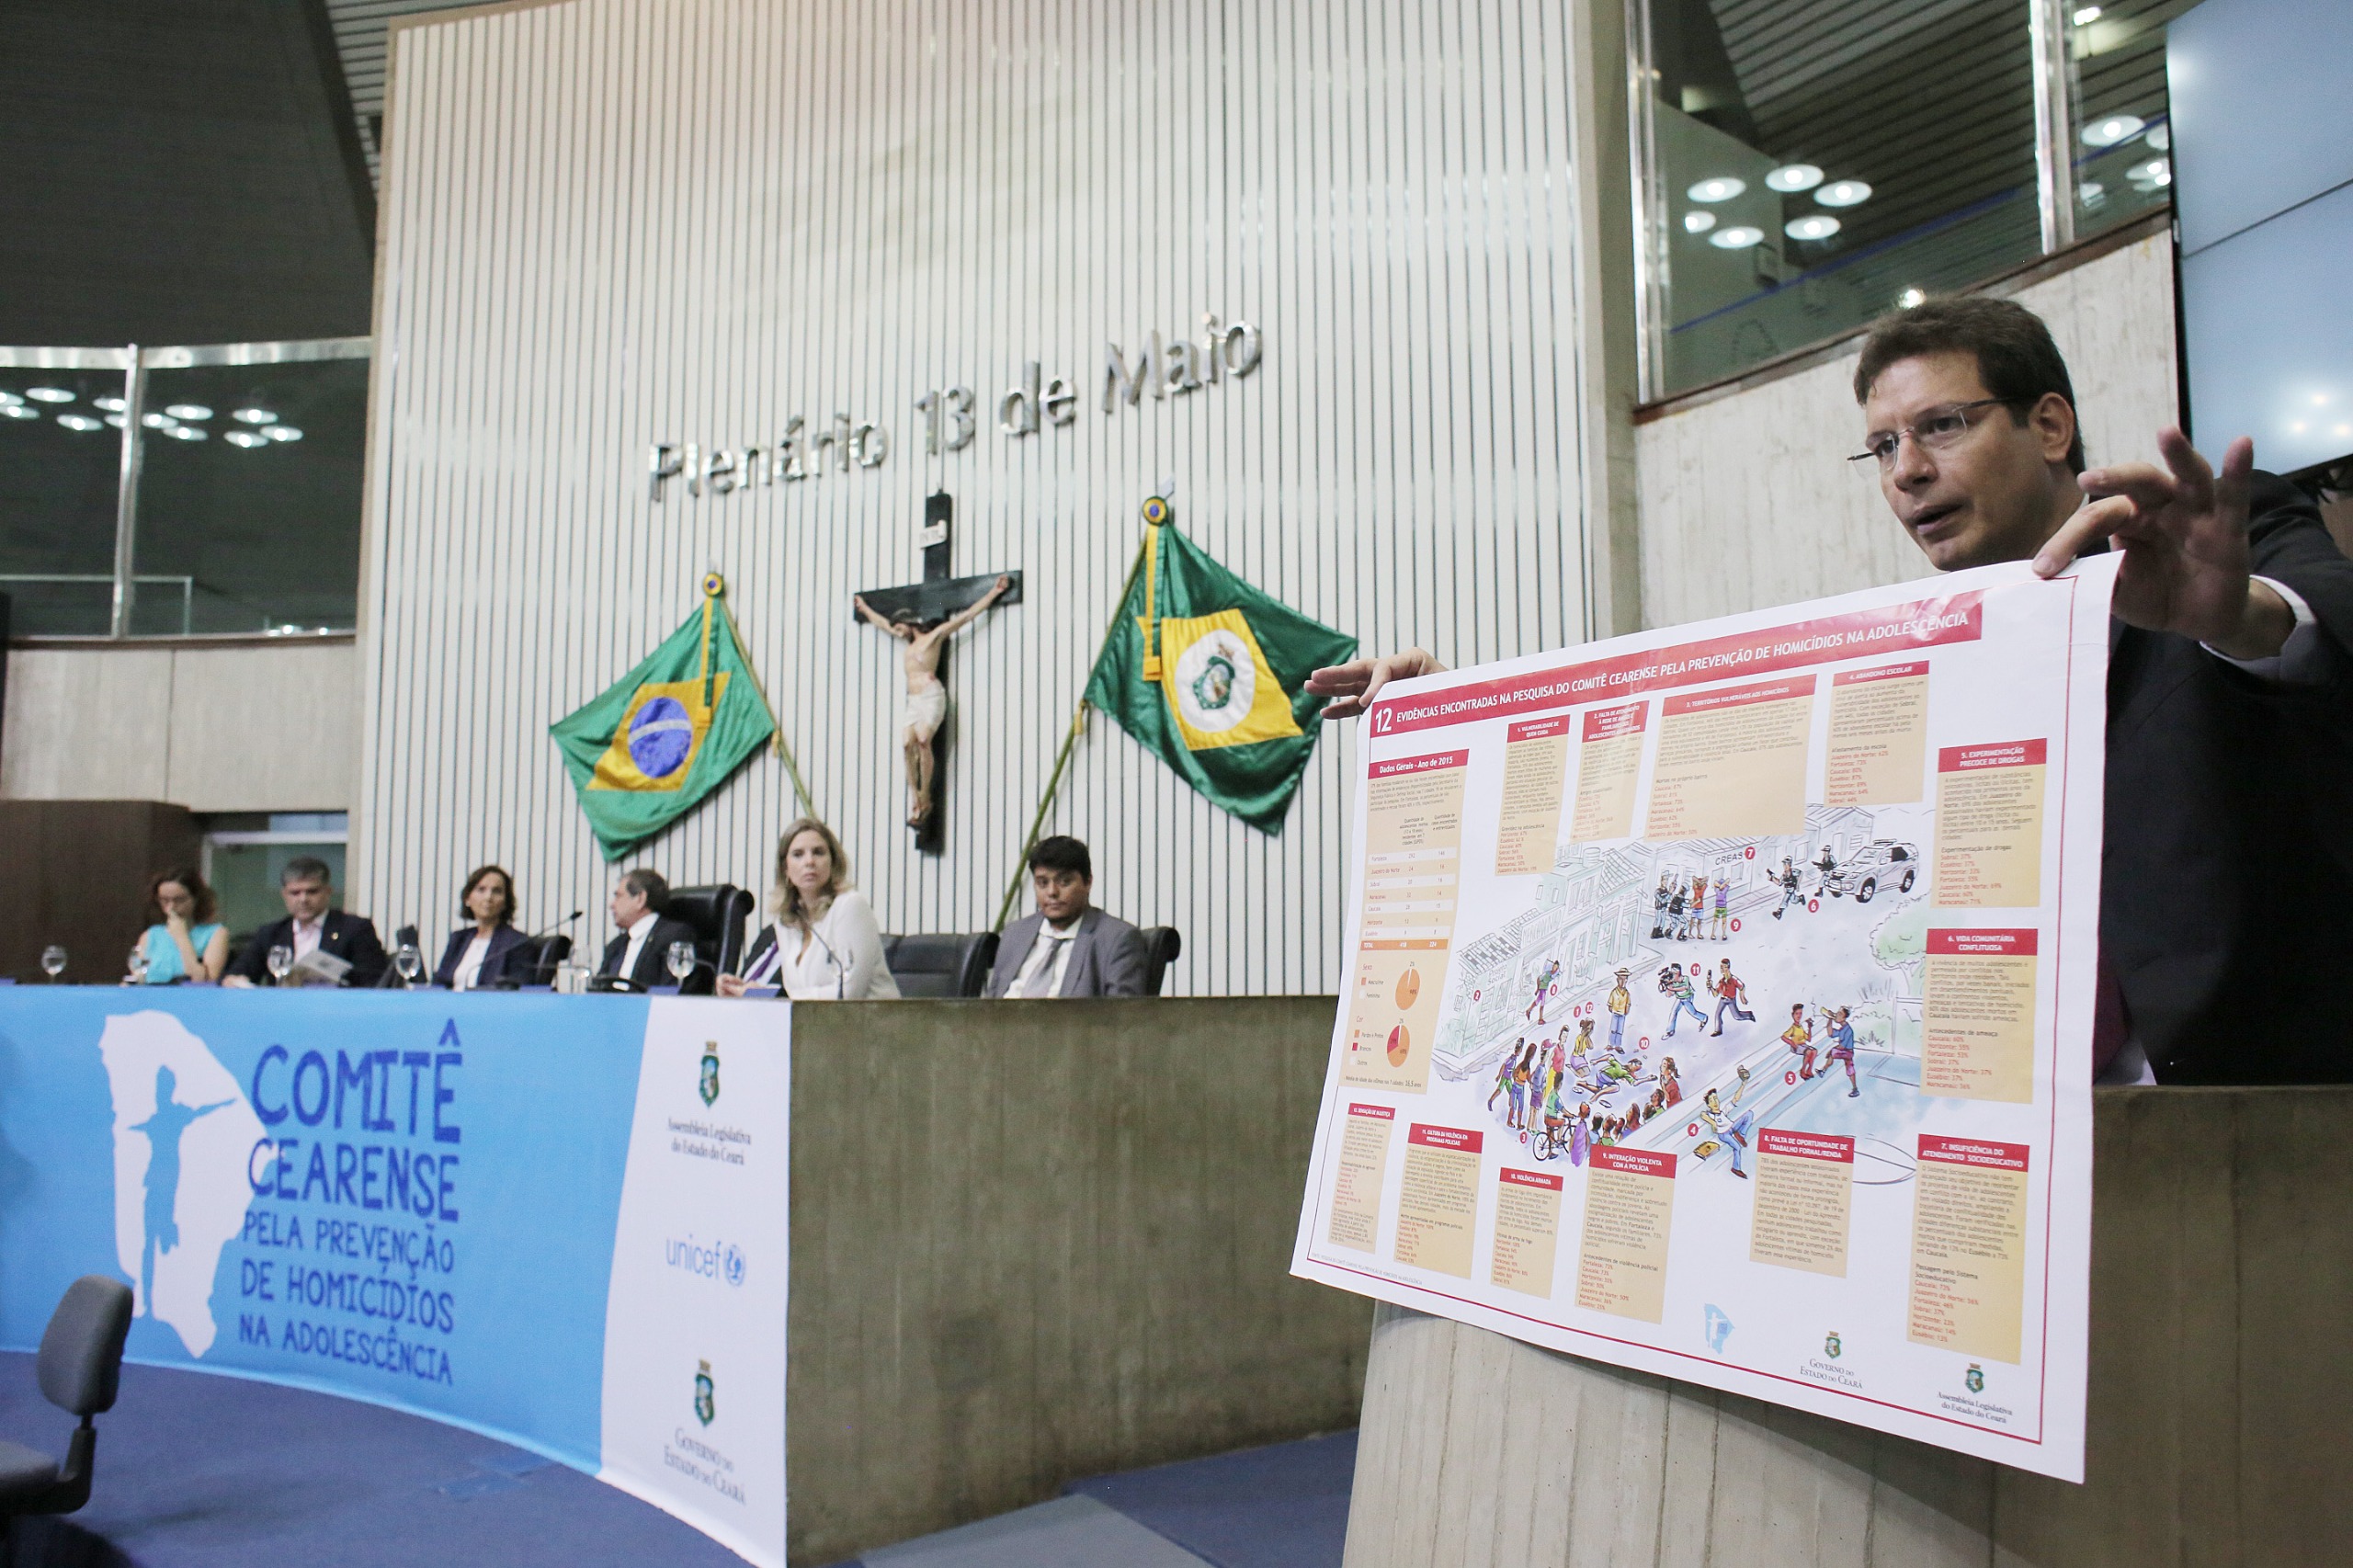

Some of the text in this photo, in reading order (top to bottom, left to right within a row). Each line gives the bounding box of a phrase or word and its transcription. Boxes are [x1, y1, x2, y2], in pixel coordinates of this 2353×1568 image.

[649, 313, 1262, 503] Plenário 13 de Maio
[1375, 611, 1968, 733] 12 EVIDÊNCIAS ENCONTRADAS NA PESQUISA DO COMITÊ CEARENSE PELA PREVENÇÃO DE HOMICÍDIOS NA ADOLESCÊNCIA
[1856, 670, 1885, 679] ABANDONO
[1887, 666, 1912, 676] ESCOLAR
[1969, 747, 2024, 757] EXPERIMENTAÇÃO
[1380, 765, 1395, 773] Dados
[1396, 762, 1413, 771] Gerais
[1438, 756, 1452, 765] 2015
[1715, 852, 1743, 865] CREAS
[252, 1017, 462, 1143] COMITÊ
[1769, 1144, 1798, 1153] TRABALHO
[1771, 1135, 1787, 1143] FALTA
[1797, 1139, 1838, 1149] OPORTUNIDADE
[1608, 1153, 1636, 1162] INTERAÇÃO
[1637, 1157, 1662, 1165] VIOLENTA
[1923, 1150, 1964, 1161] ATENDIMENTO
[1629, 1163, 1649, 1172] POLÍCIA
[249, 1137, 460, 1222] CEARENSE
[243, 1210, 453, 1279] PELA PREVENÇÃO
[666, 1233, 722, 1280] unicef
[241, 1258, 453, 1334] DE HOMICÍDIOS
[239, 1313, 452, 1386] NA ADOLESCÊNCIA
[1938, 1391, 2013, 1415] Assembleia Legislativa
[1941, 1401, 1950, 1409] do
[1951, 1403, 1973, 1415] Estado
[1974, 1409, 1984, 1417] do
